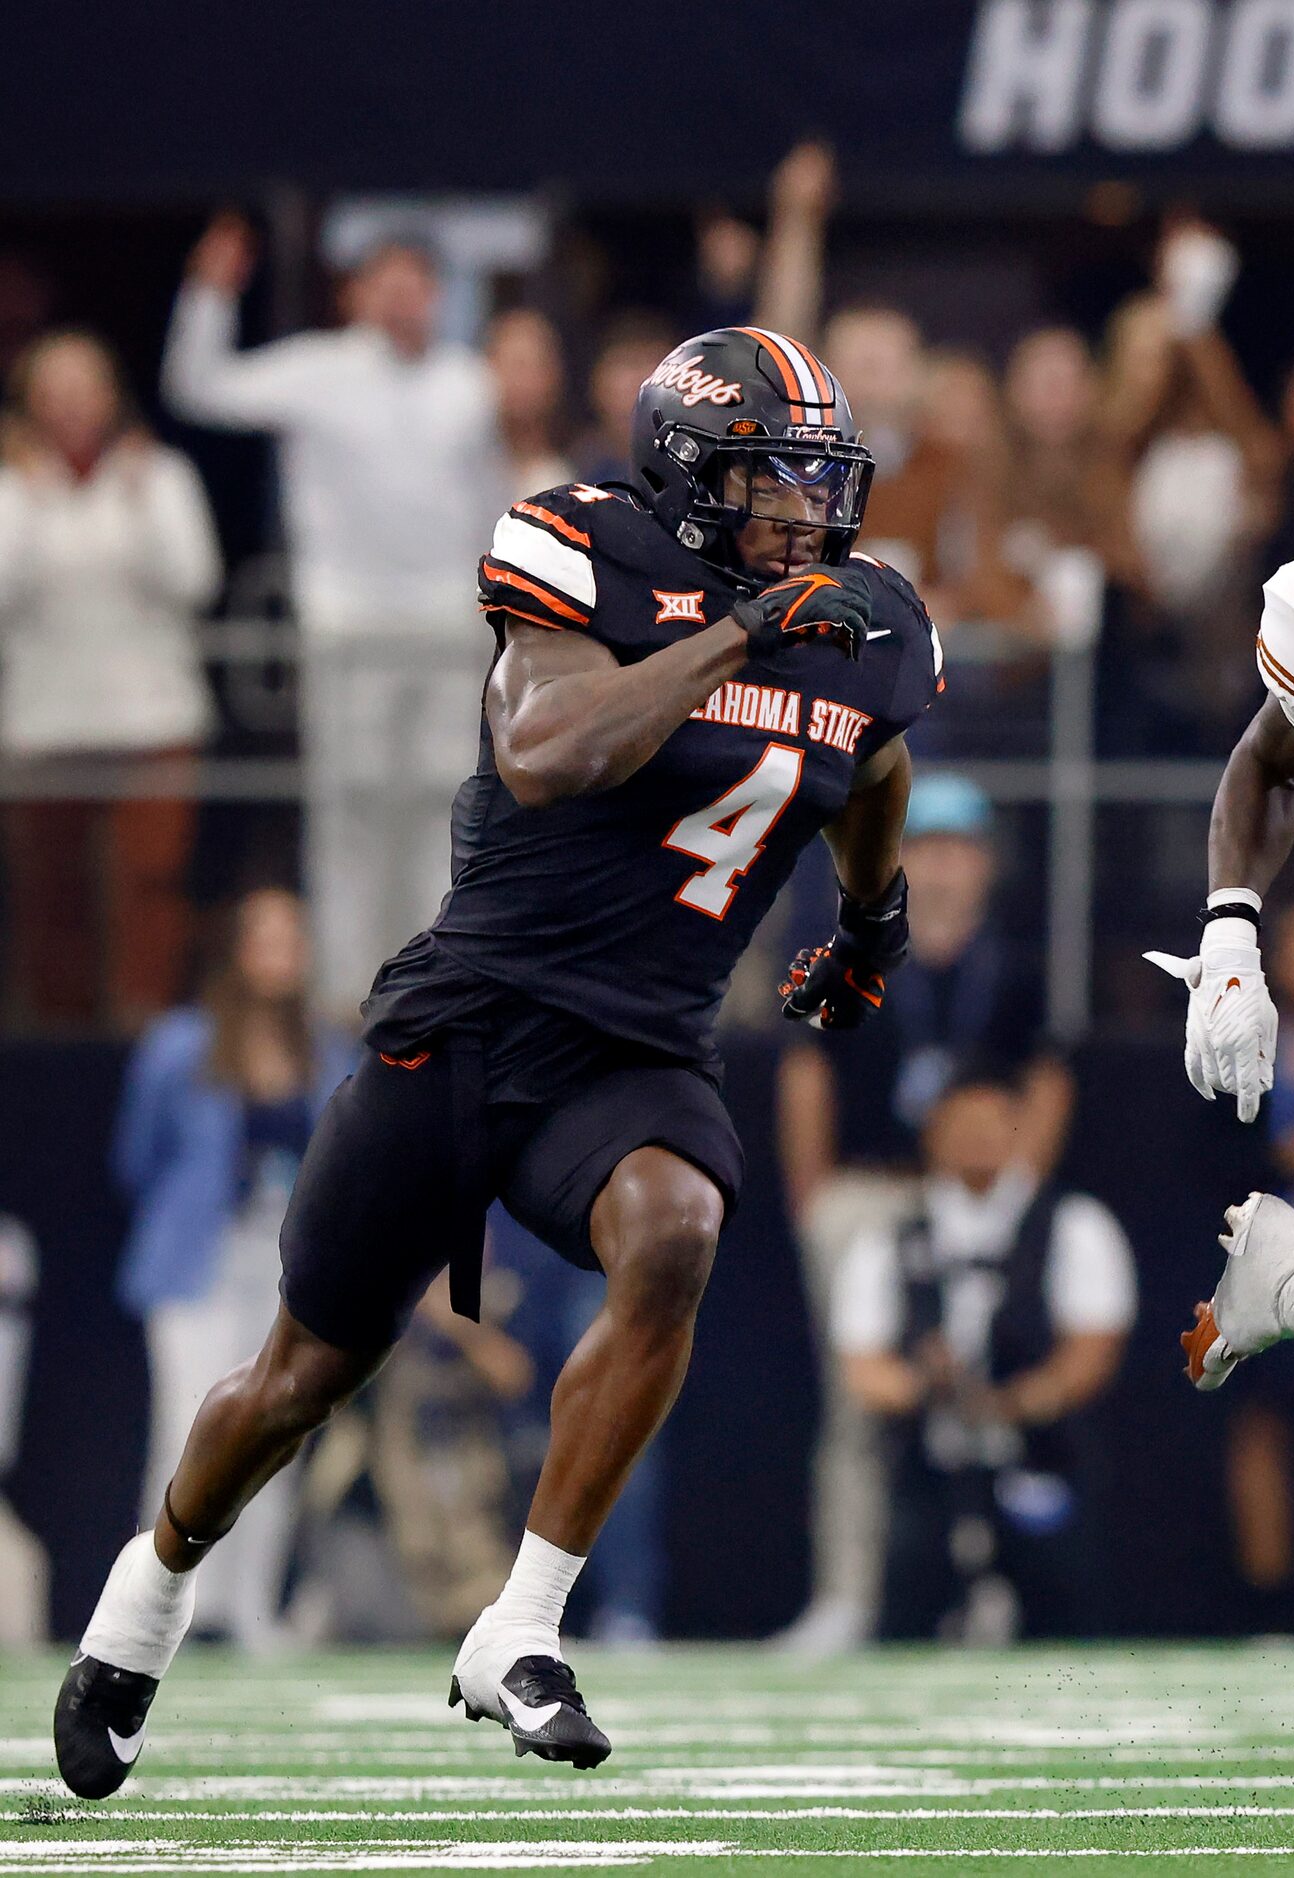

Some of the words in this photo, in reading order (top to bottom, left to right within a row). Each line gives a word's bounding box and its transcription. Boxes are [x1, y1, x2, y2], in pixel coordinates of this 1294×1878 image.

[653, 590, 706, 624] XII
[689, 681, 802, 737] AHOMA
[807, 698, 873, 755] STATE
[661, 741, 805, 921] 4
